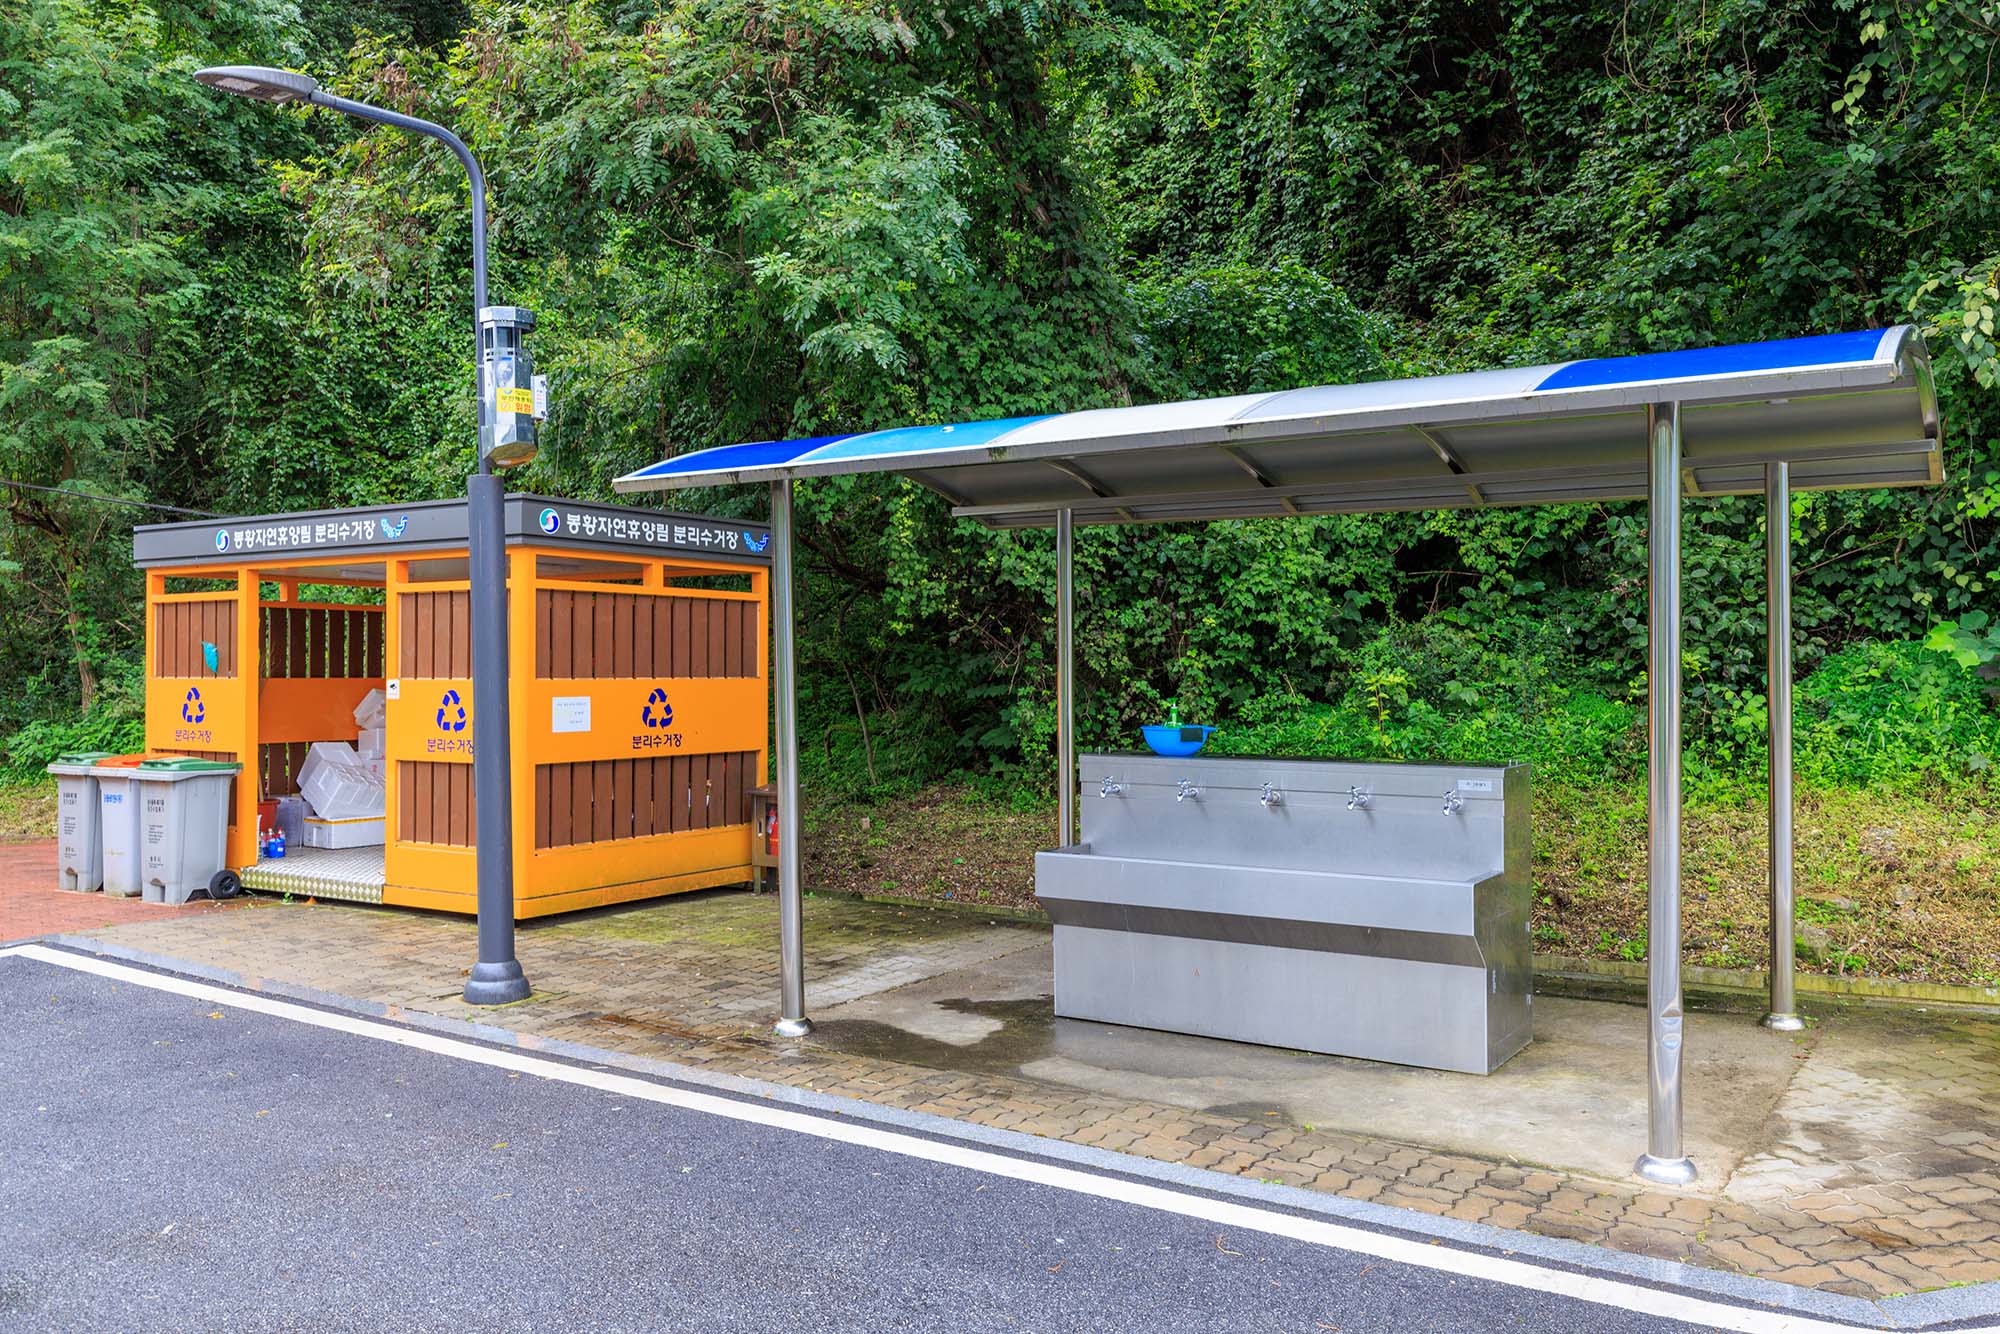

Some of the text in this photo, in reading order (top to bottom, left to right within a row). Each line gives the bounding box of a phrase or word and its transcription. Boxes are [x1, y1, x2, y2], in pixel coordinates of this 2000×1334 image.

[233, 520, 376, 549] 봉황자연휴양림 분리수거장
[566, 513, 738, 550] 봉황자연휴양림 분리수거장
[175, 729, 212, 743] 분리수거장
[632, 733, 682, 749] 분리수거장
